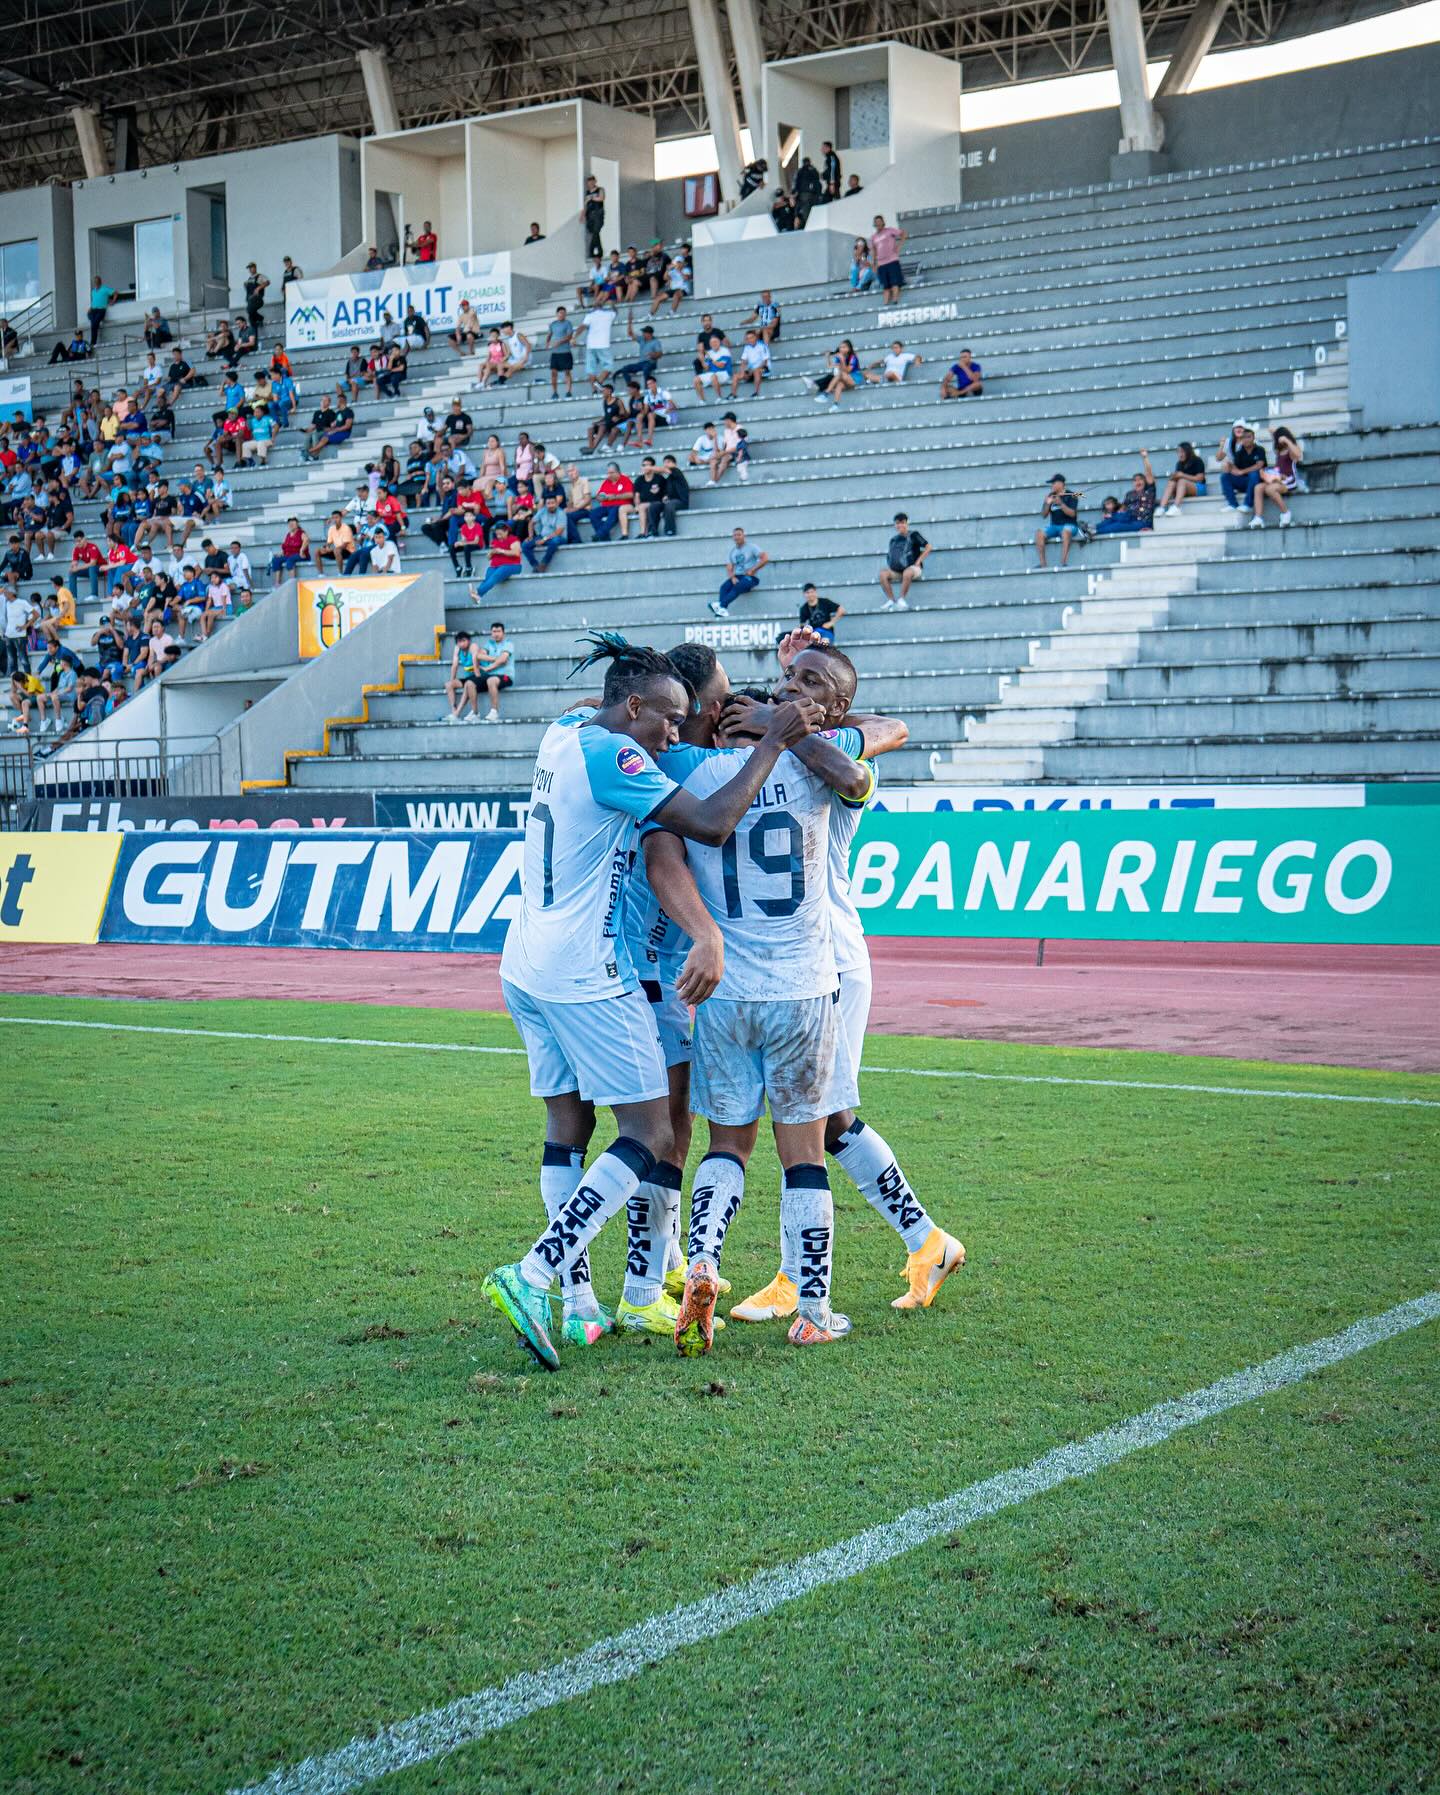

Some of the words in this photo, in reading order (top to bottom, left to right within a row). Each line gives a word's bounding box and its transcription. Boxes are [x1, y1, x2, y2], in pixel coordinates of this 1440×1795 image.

[333, 286, 452, 328] ARKILIT
[878, 303, 957, 328] PREFERENCIA
[685, 622, 781, 646] PREFERENCIA
[534, 766, 554, 793] YOVI
[603, 847, 628, 938] Fibramax
[721, 810, 806, 918] 19
[848, 839, 1393, 915] BANARIEGO
[534, 1185, 606, 1268] GUTMAN
[876, 1161, 925, 1230] GUTMAN
[625, 1195, 651, 1277] GUTMAN
[800, 1227, 831, 1298] GUTMAN
